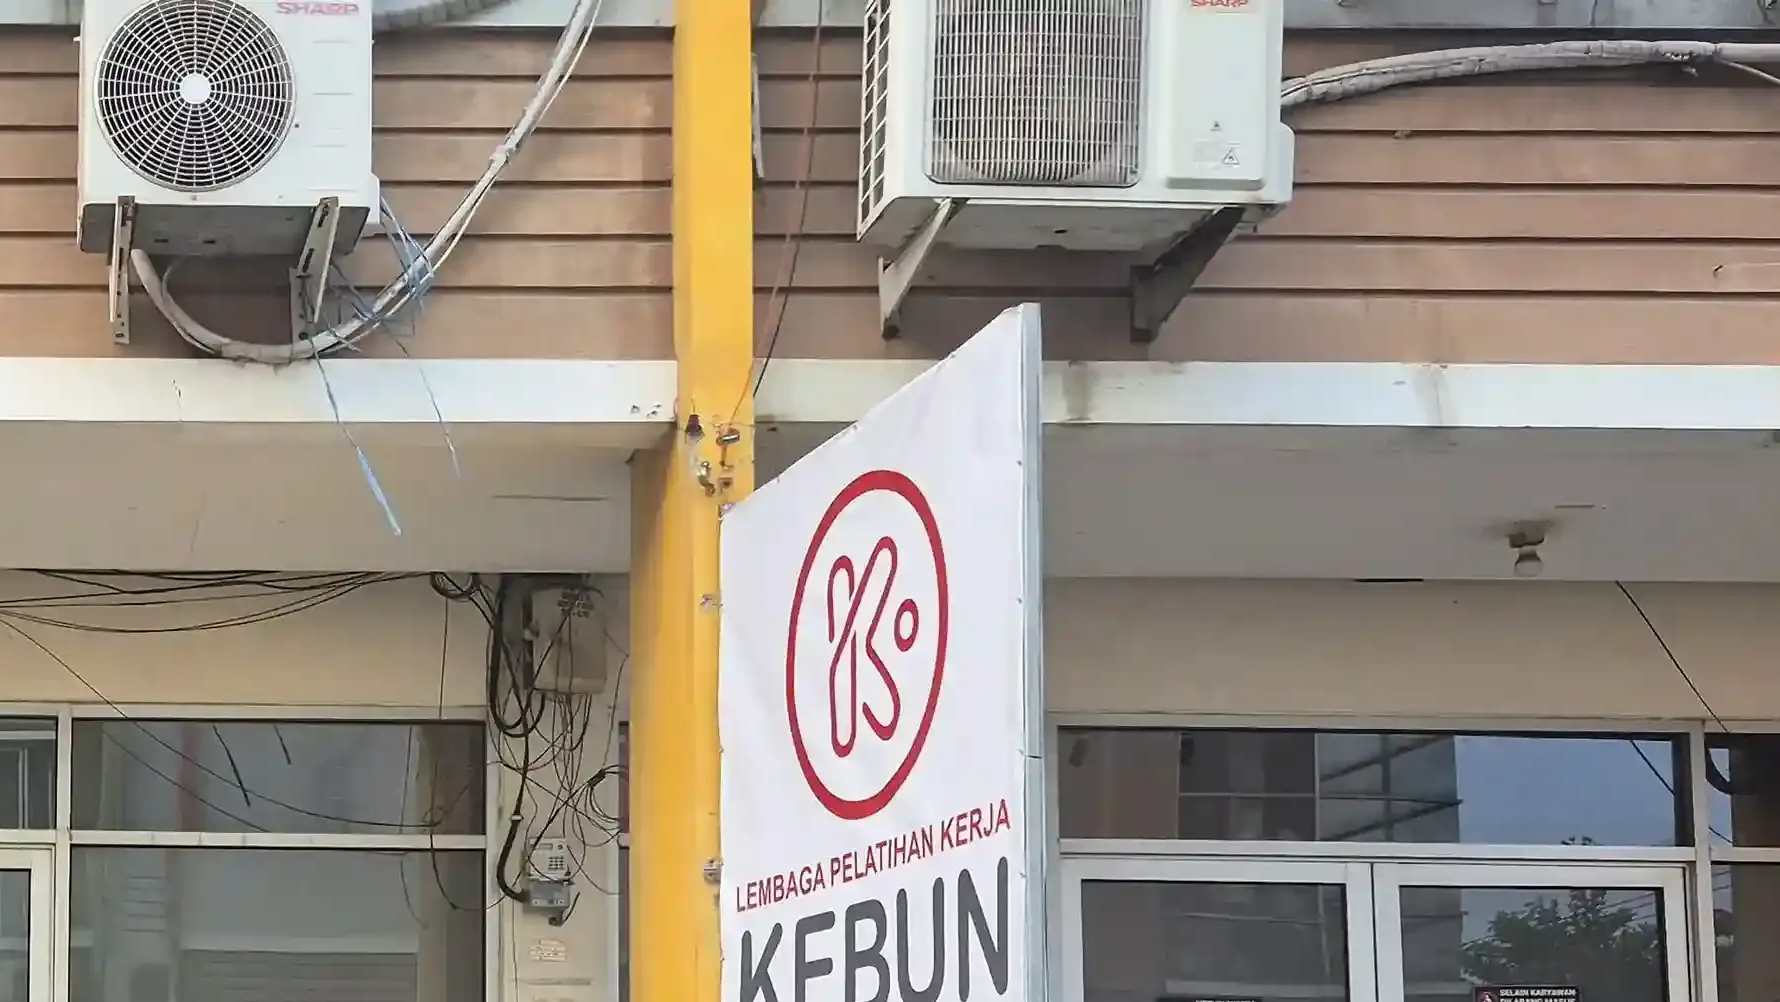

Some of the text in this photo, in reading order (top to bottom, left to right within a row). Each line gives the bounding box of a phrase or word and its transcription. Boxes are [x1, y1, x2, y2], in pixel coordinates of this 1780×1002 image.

[276, 3, 359, 15] SHARP
[736, 798, 1011, 912] LEMBAGA PELATIHAN KERJA
